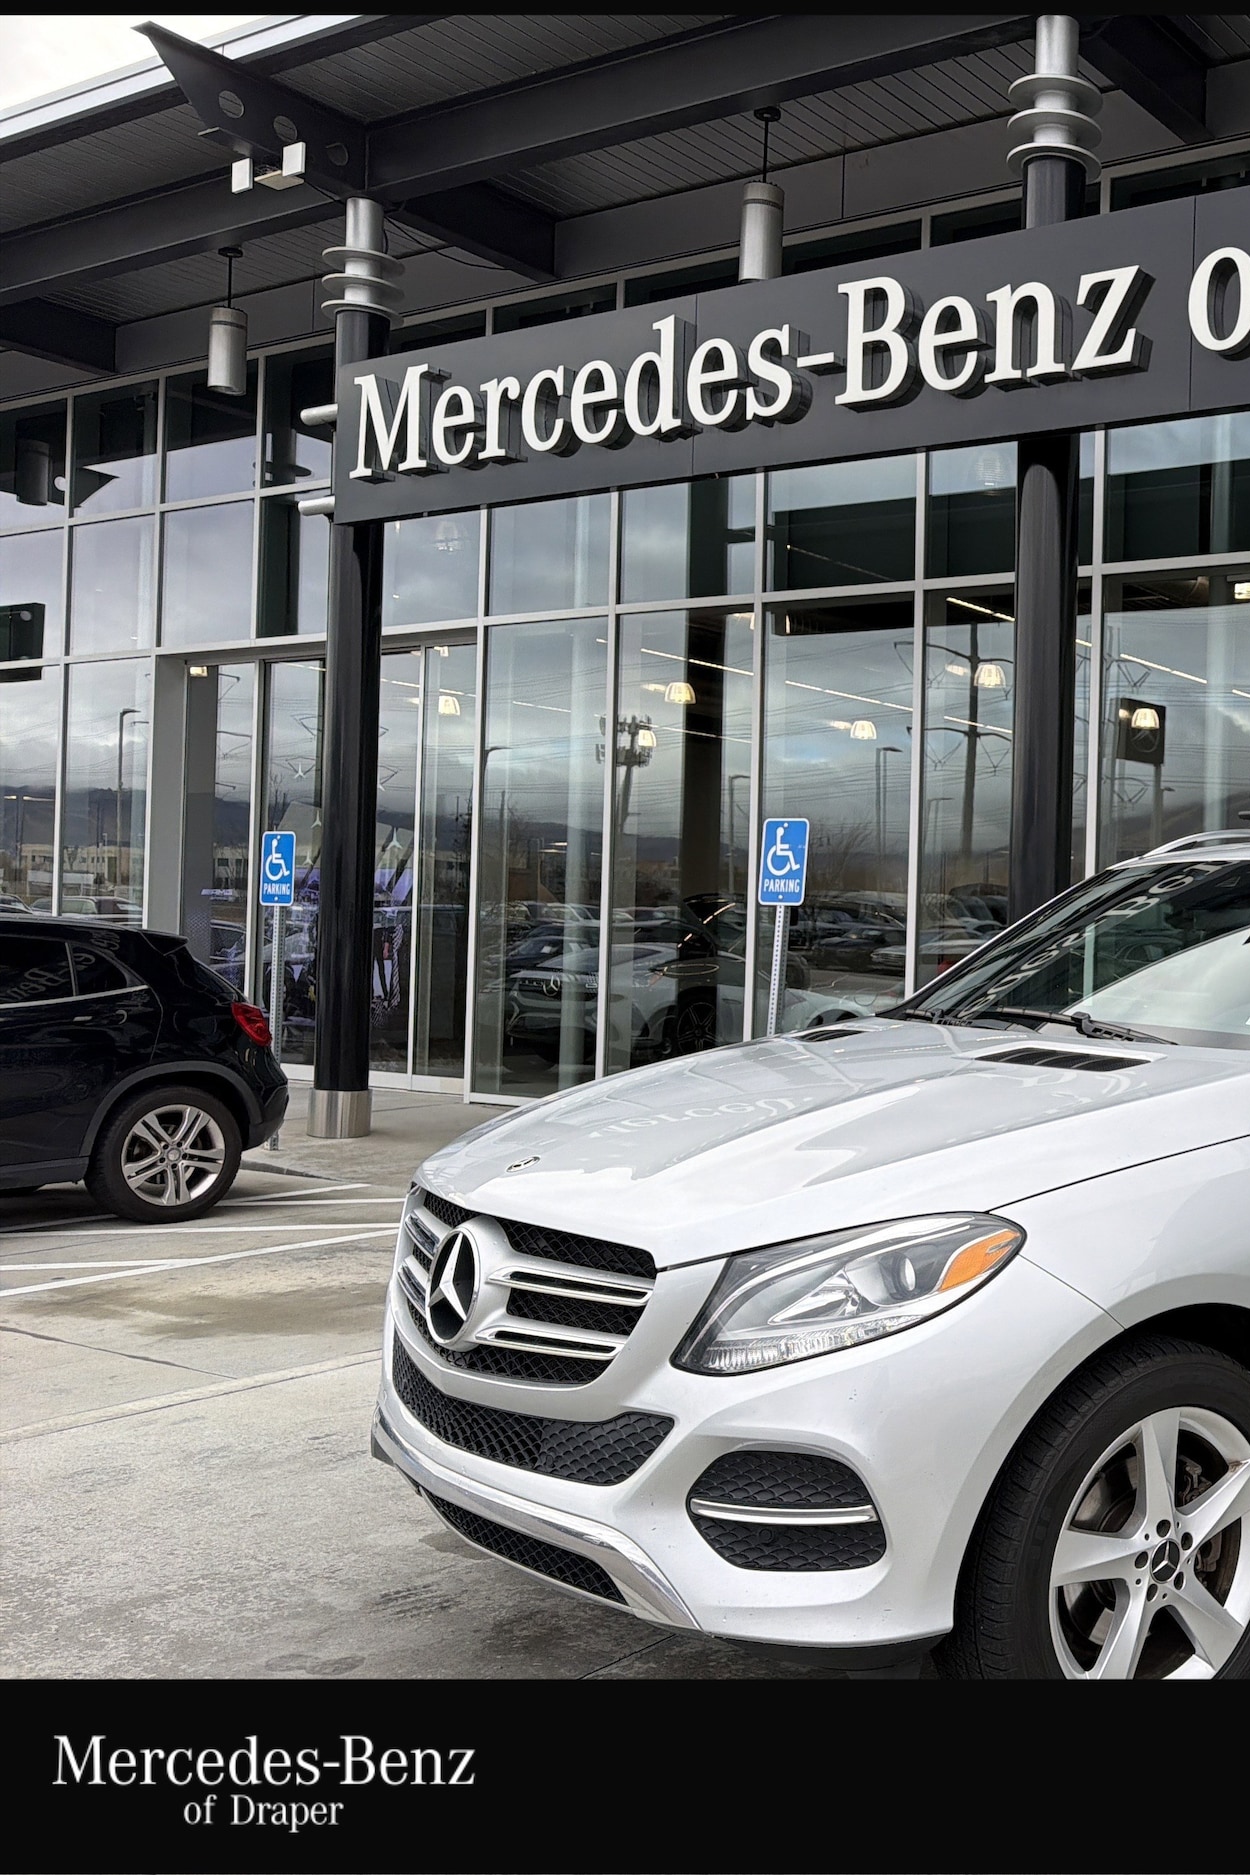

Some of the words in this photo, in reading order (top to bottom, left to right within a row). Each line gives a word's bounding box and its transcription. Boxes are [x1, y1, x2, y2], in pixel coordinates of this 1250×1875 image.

[349, 265, 1140, 479] Mercedes-Benz
[263, 883, 290, 895] PARKING
[763, 878, 801, 893] PARKING
